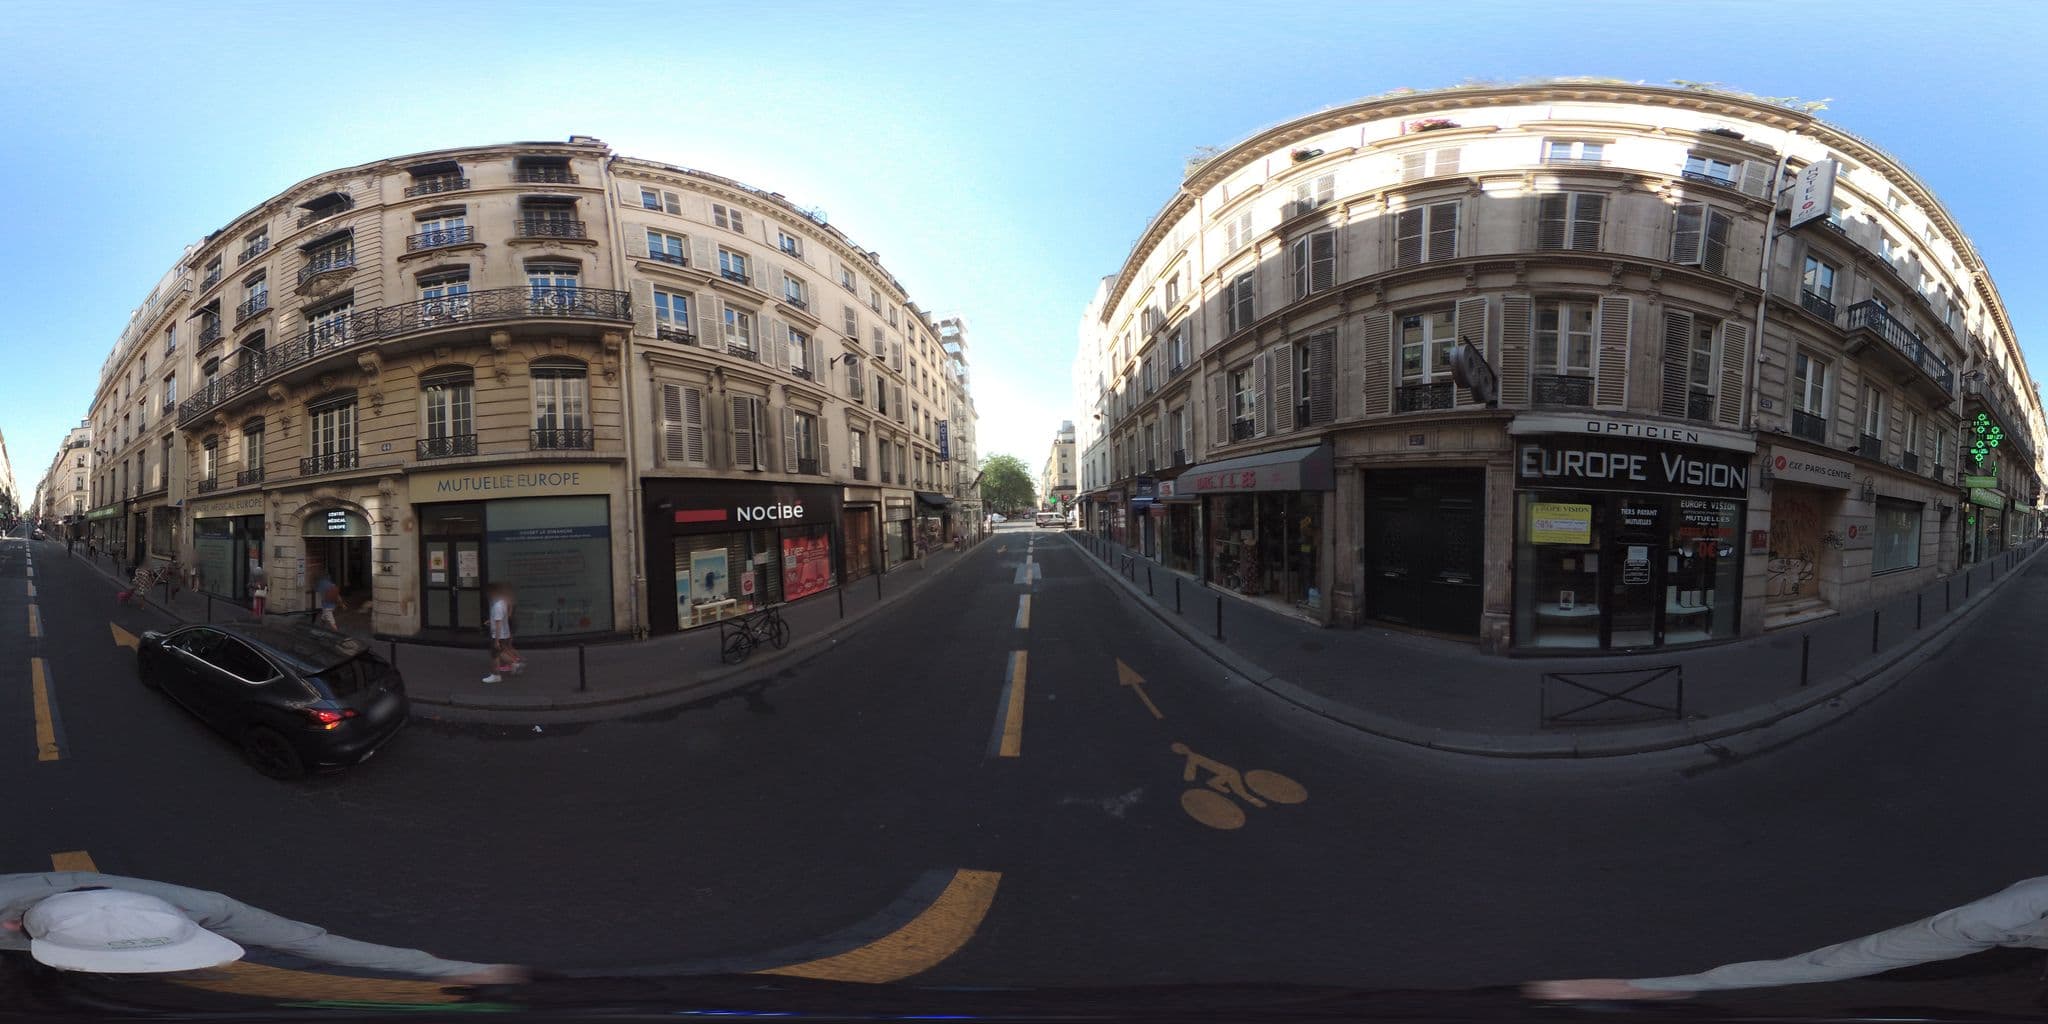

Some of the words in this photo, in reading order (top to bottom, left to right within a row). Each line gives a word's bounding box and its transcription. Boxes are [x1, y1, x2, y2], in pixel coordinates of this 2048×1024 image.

[1587, 421, 1699, 443] OPTICIEN
[1521, 446, 1648, 481] EUROPE
[1660, 452, 1746, 490] VISION
[1805, 463, 1826, 475] PARIS
[1827, 468, 1852, 481] CENTRE
[437, 474, 514, 492] MUTUELLE
[517, 473, 580, 488] EUROPE
[236, 499, 264, 510] EUROPE
[1537, 504, 1562, 512] ROPE
[1563, 505, 1588, 513] VISION
[1680, 500, 1707, 509] EUROPE
[1711, 501, 1736, 511] VISION
[1685, 515, 1730, 523] MUTUELLES
